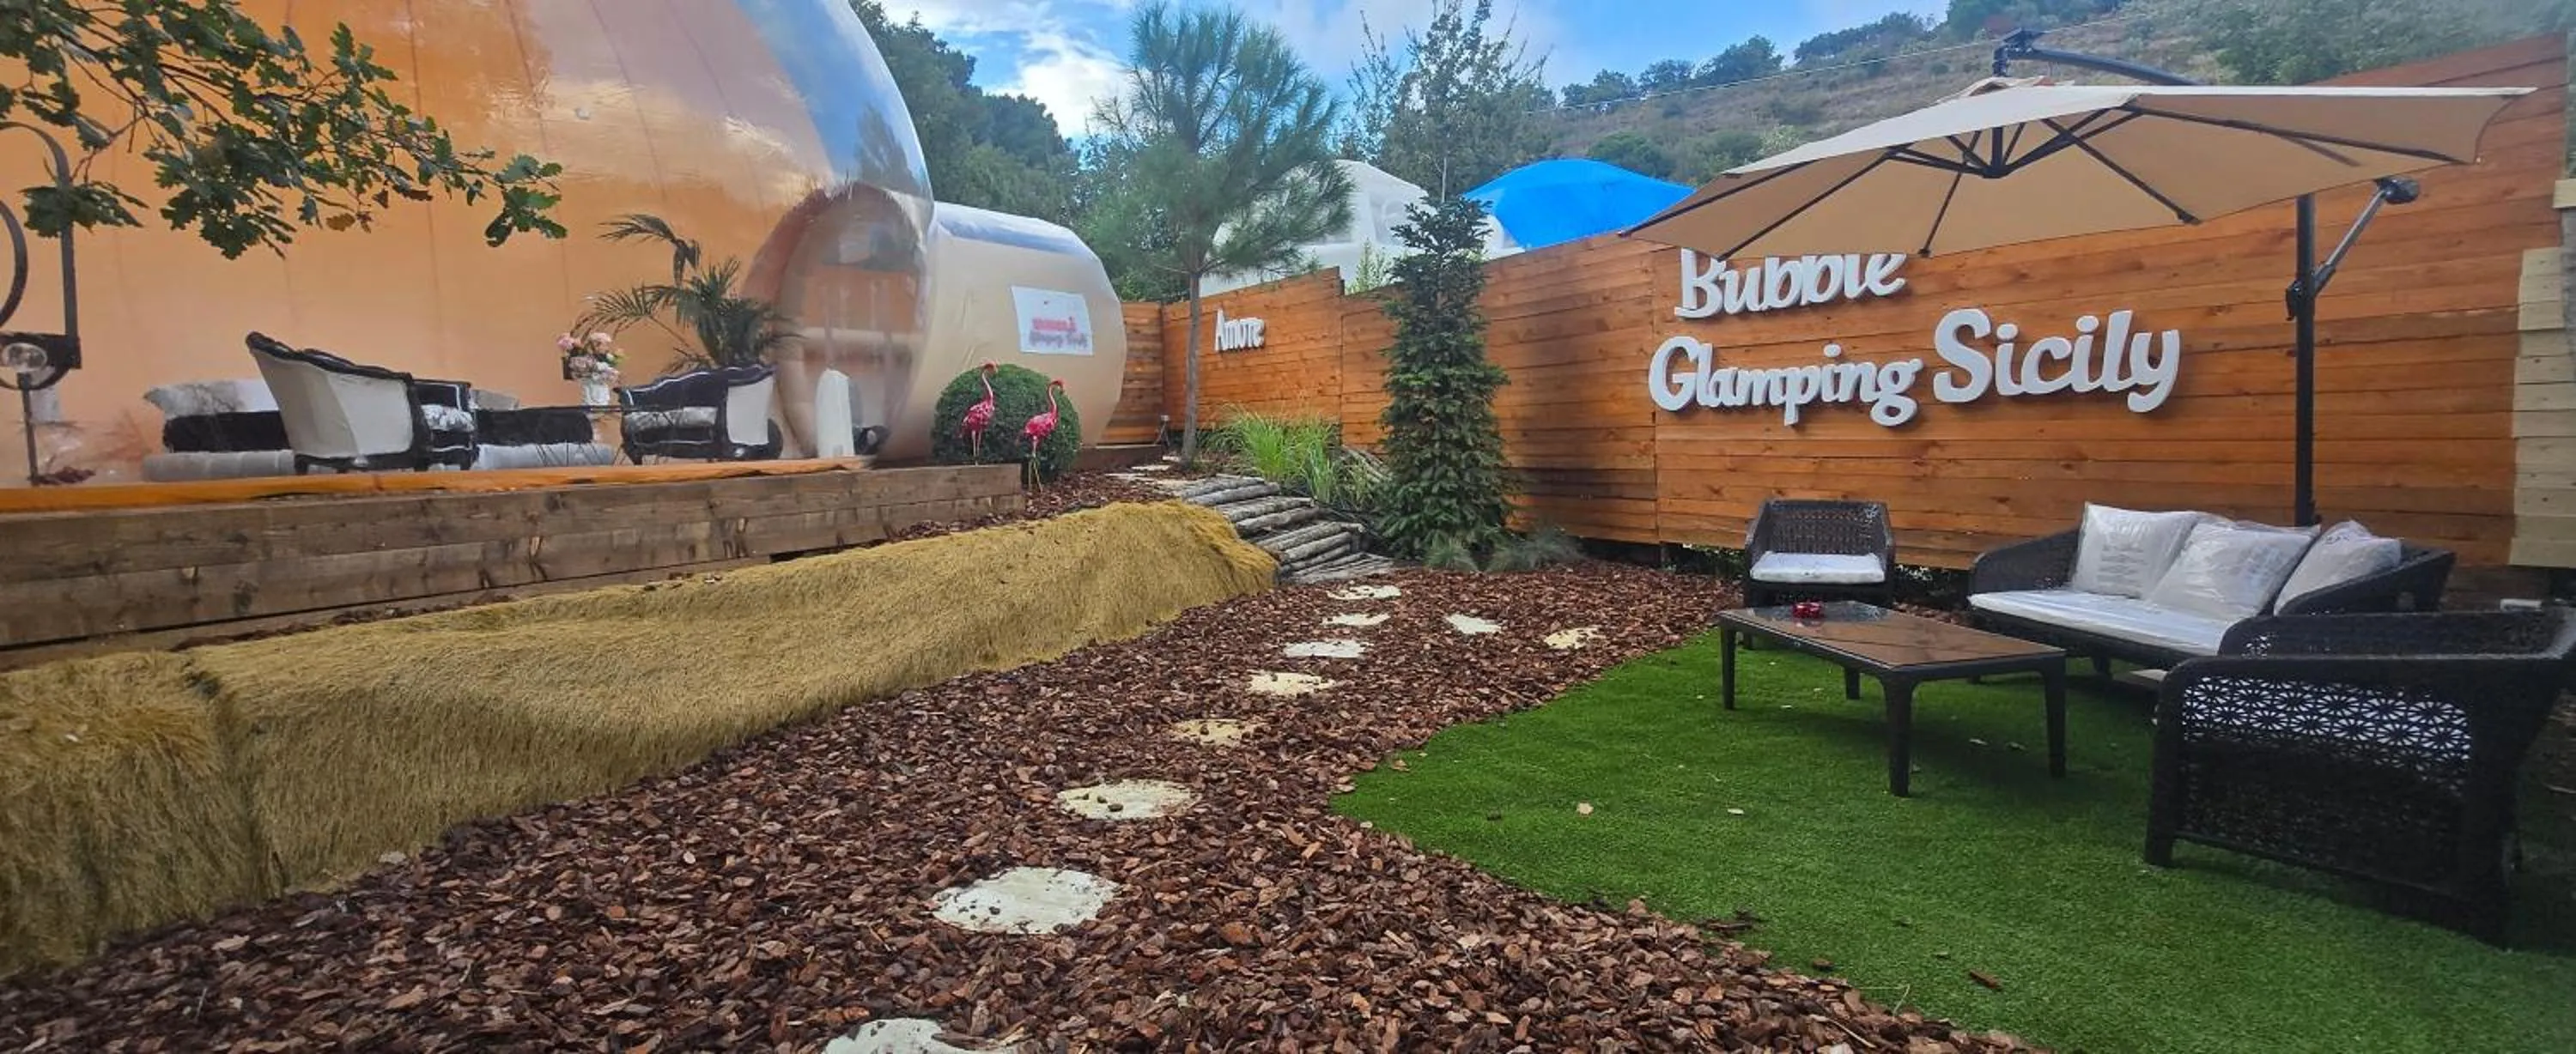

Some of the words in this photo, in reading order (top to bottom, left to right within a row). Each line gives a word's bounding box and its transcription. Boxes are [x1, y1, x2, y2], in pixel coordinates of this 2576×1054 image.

[1215, 309, 1265, 351] Amore
[1649, 336, 1923, 427] Glamping
[1934, 308, 2180, 412] Sicily
